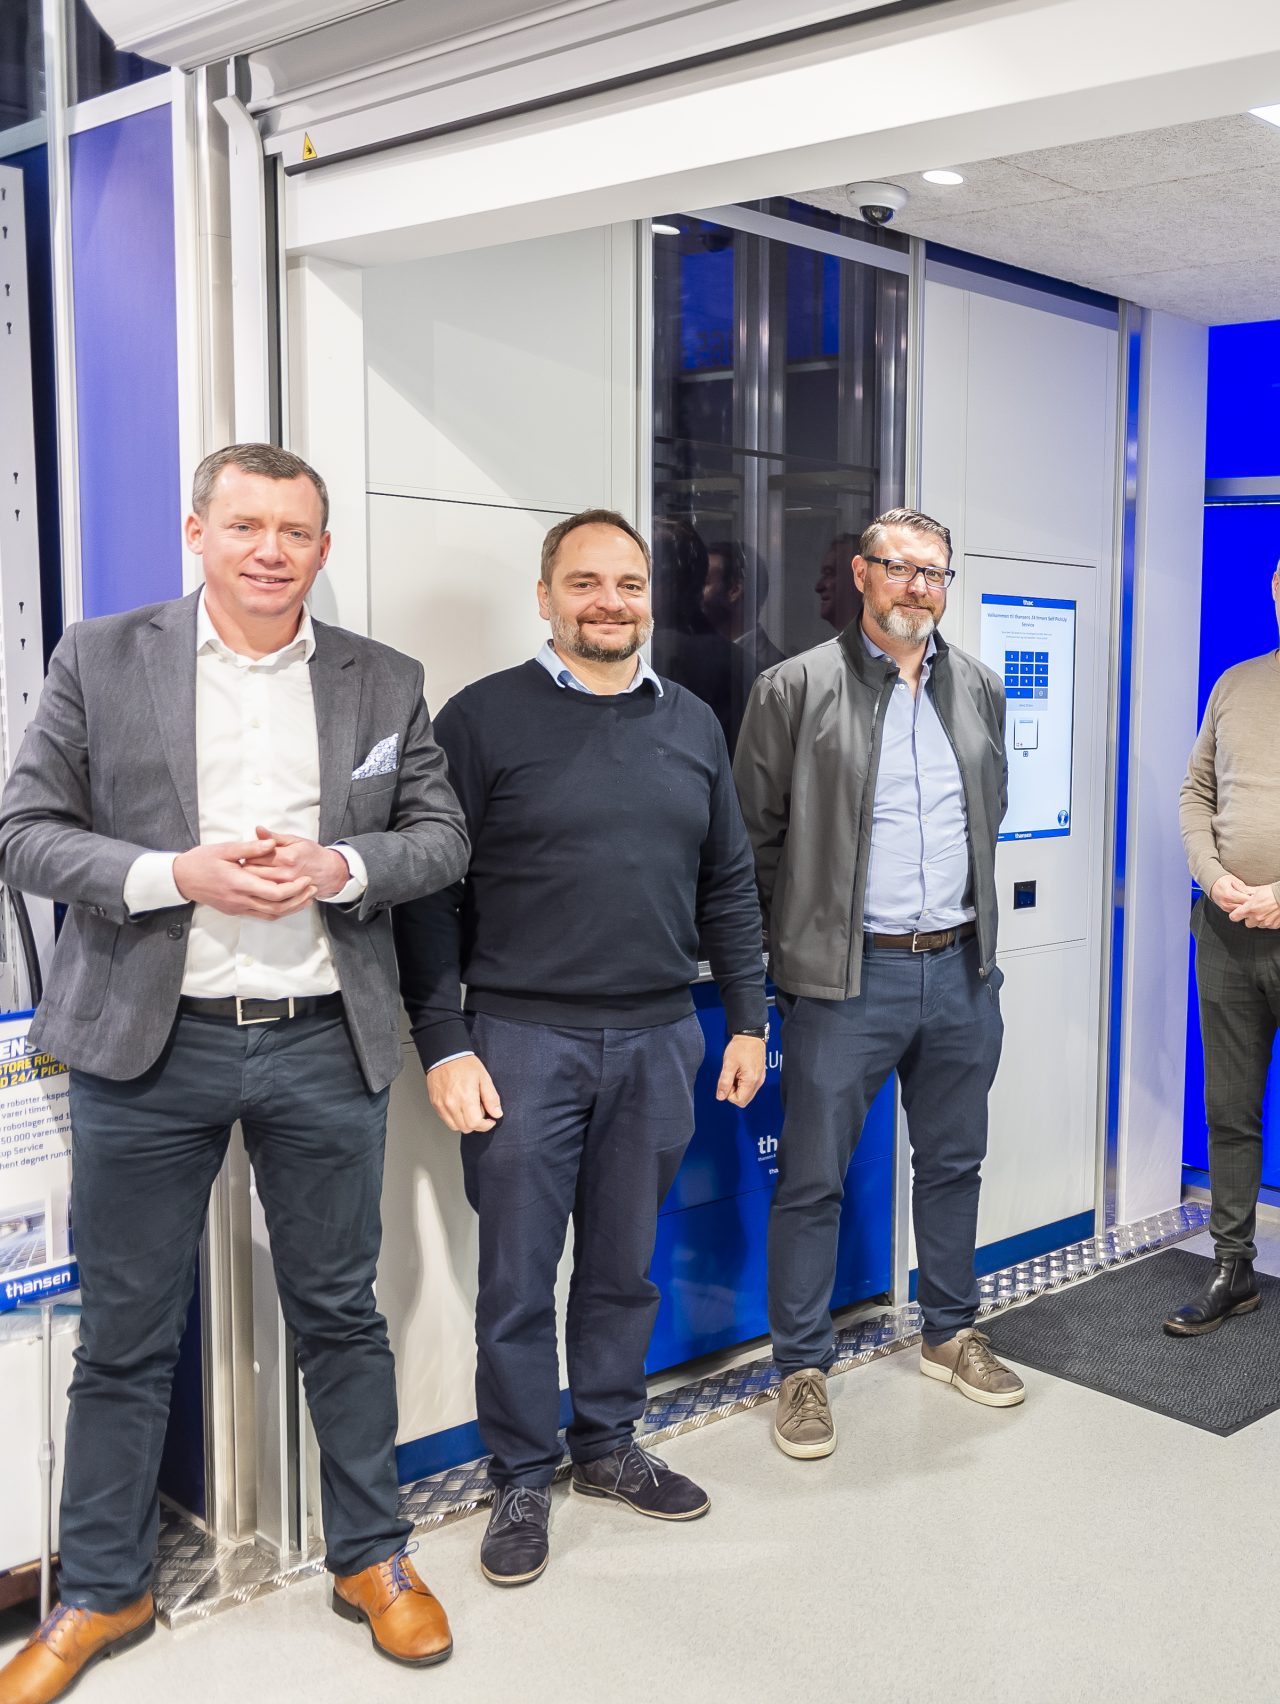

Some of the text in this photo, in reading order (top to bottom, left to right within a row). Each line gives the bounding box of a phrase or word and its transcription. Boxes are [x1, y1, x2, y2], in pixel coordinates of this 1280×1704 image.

[11, 1069, 38, 1086] 24/7
[7, 1096, 39, 1108] robotter
[2, 1110, 22, 1119] varer
[29, 1105, 52, 1114] timen
[3, 1119, 45, 1132] robotlager
[47, 1112, 63, 1122] med
[14, 1143, 44, 1155] Service
[51, 1149, 71, 1160] rundt
[6, 1270, 71, 1299] thansen
